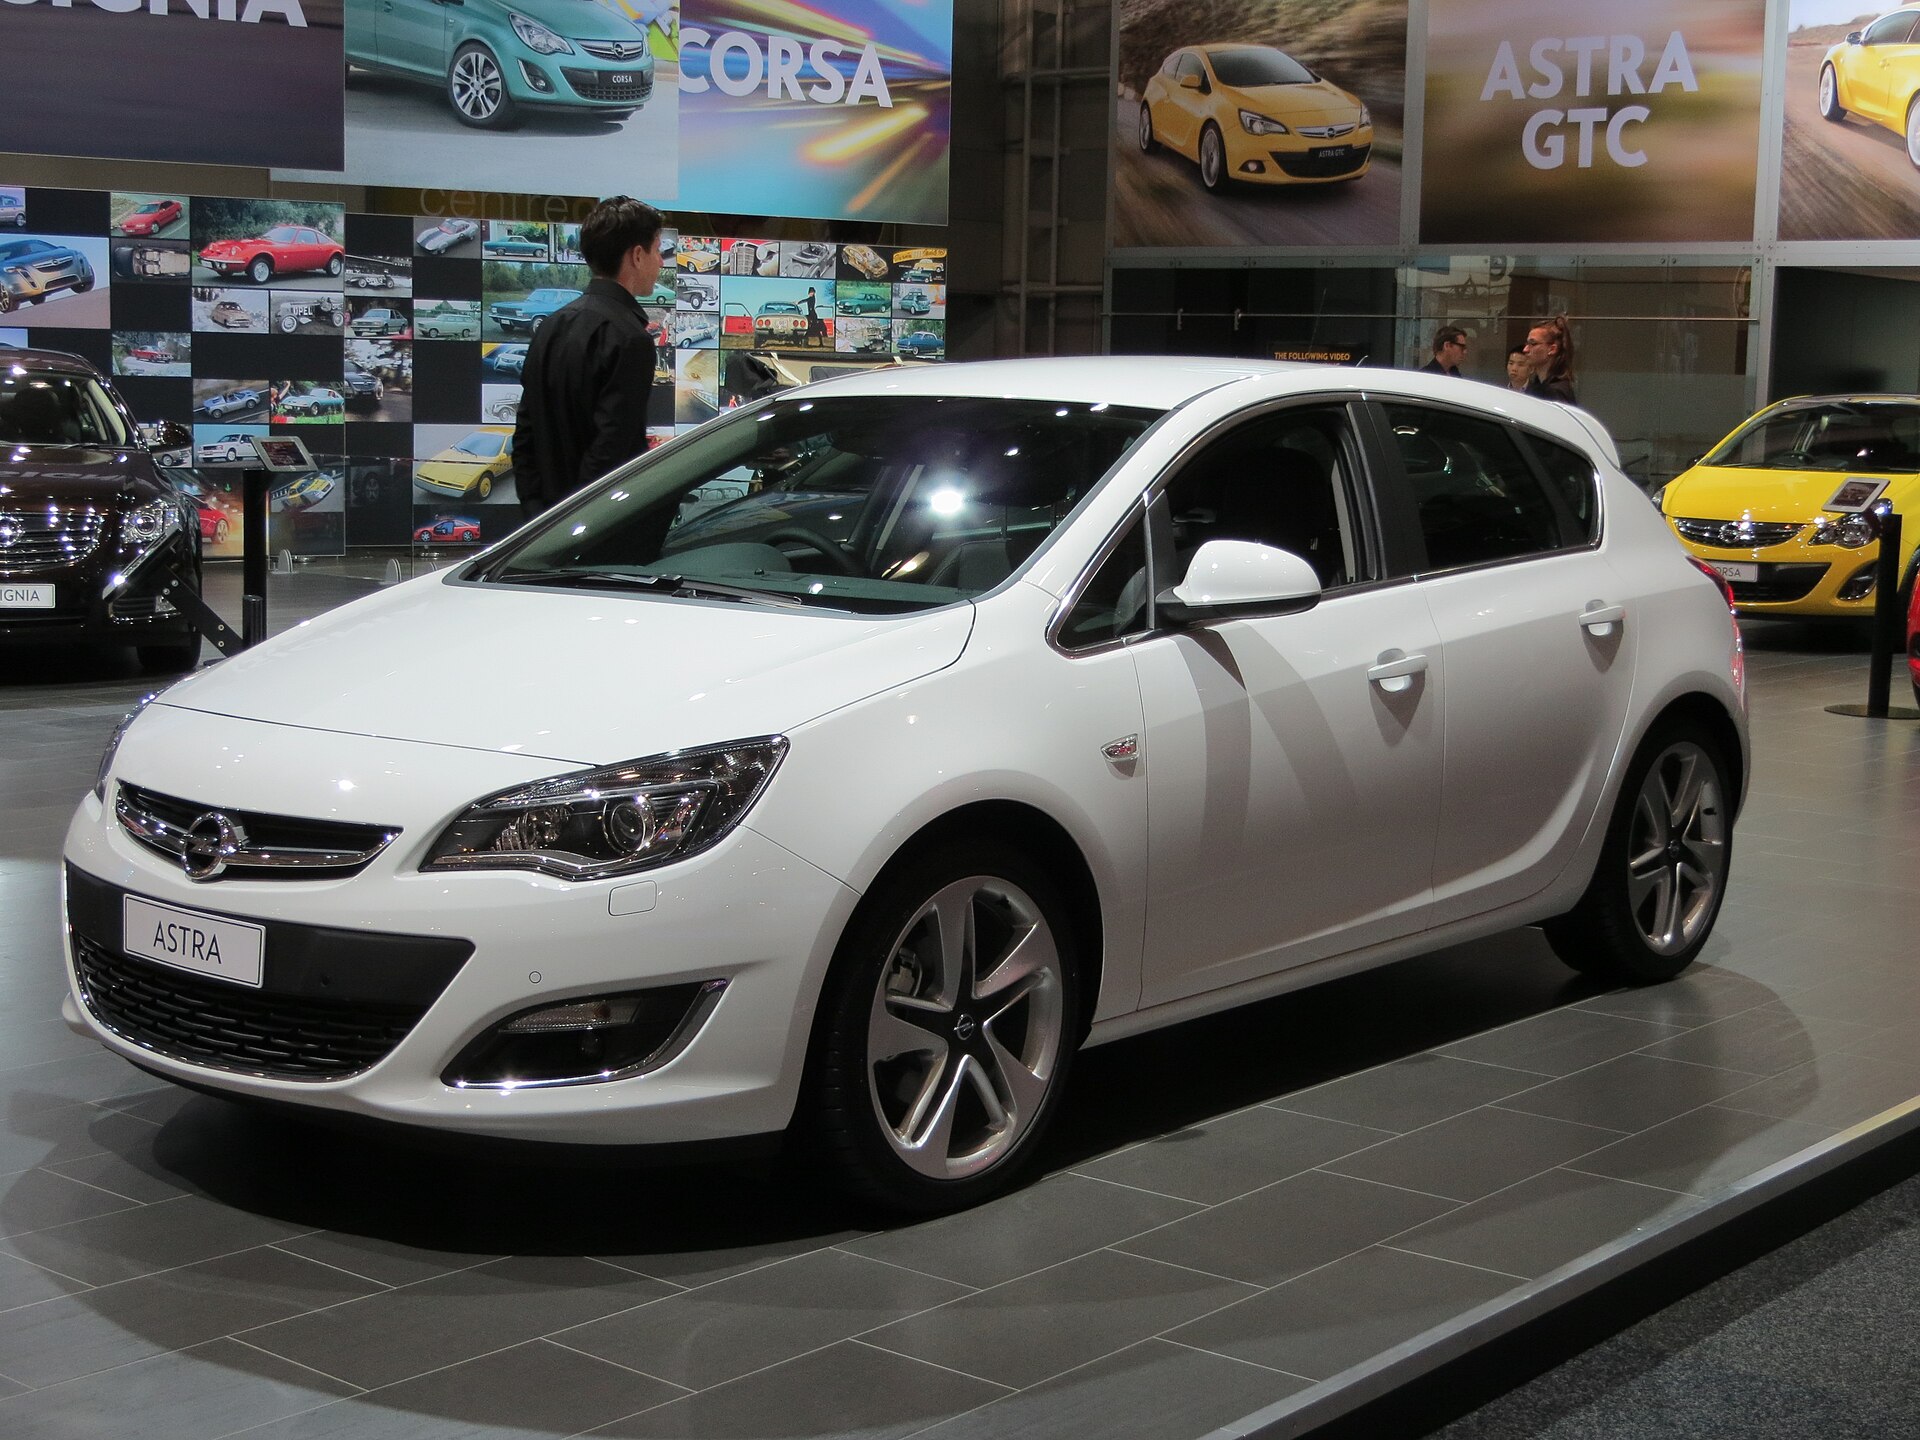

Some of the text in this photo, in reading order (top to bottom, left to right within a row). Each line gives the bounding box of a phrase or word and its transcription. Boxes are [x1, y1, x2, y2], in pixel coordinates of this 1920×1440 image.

[612, 75, 633, 83] CORSA
[679, 27, 893, 108] CORSA
[1480, 31, 1698, 101] ASTRA
[1319, 150, 1335, 158] ASTRA
[1521, 105, 1650, 170] GTC
[1288, 352, 1328, 360] FOLLOWING
[153, 920, 222, 965] ASTRA
